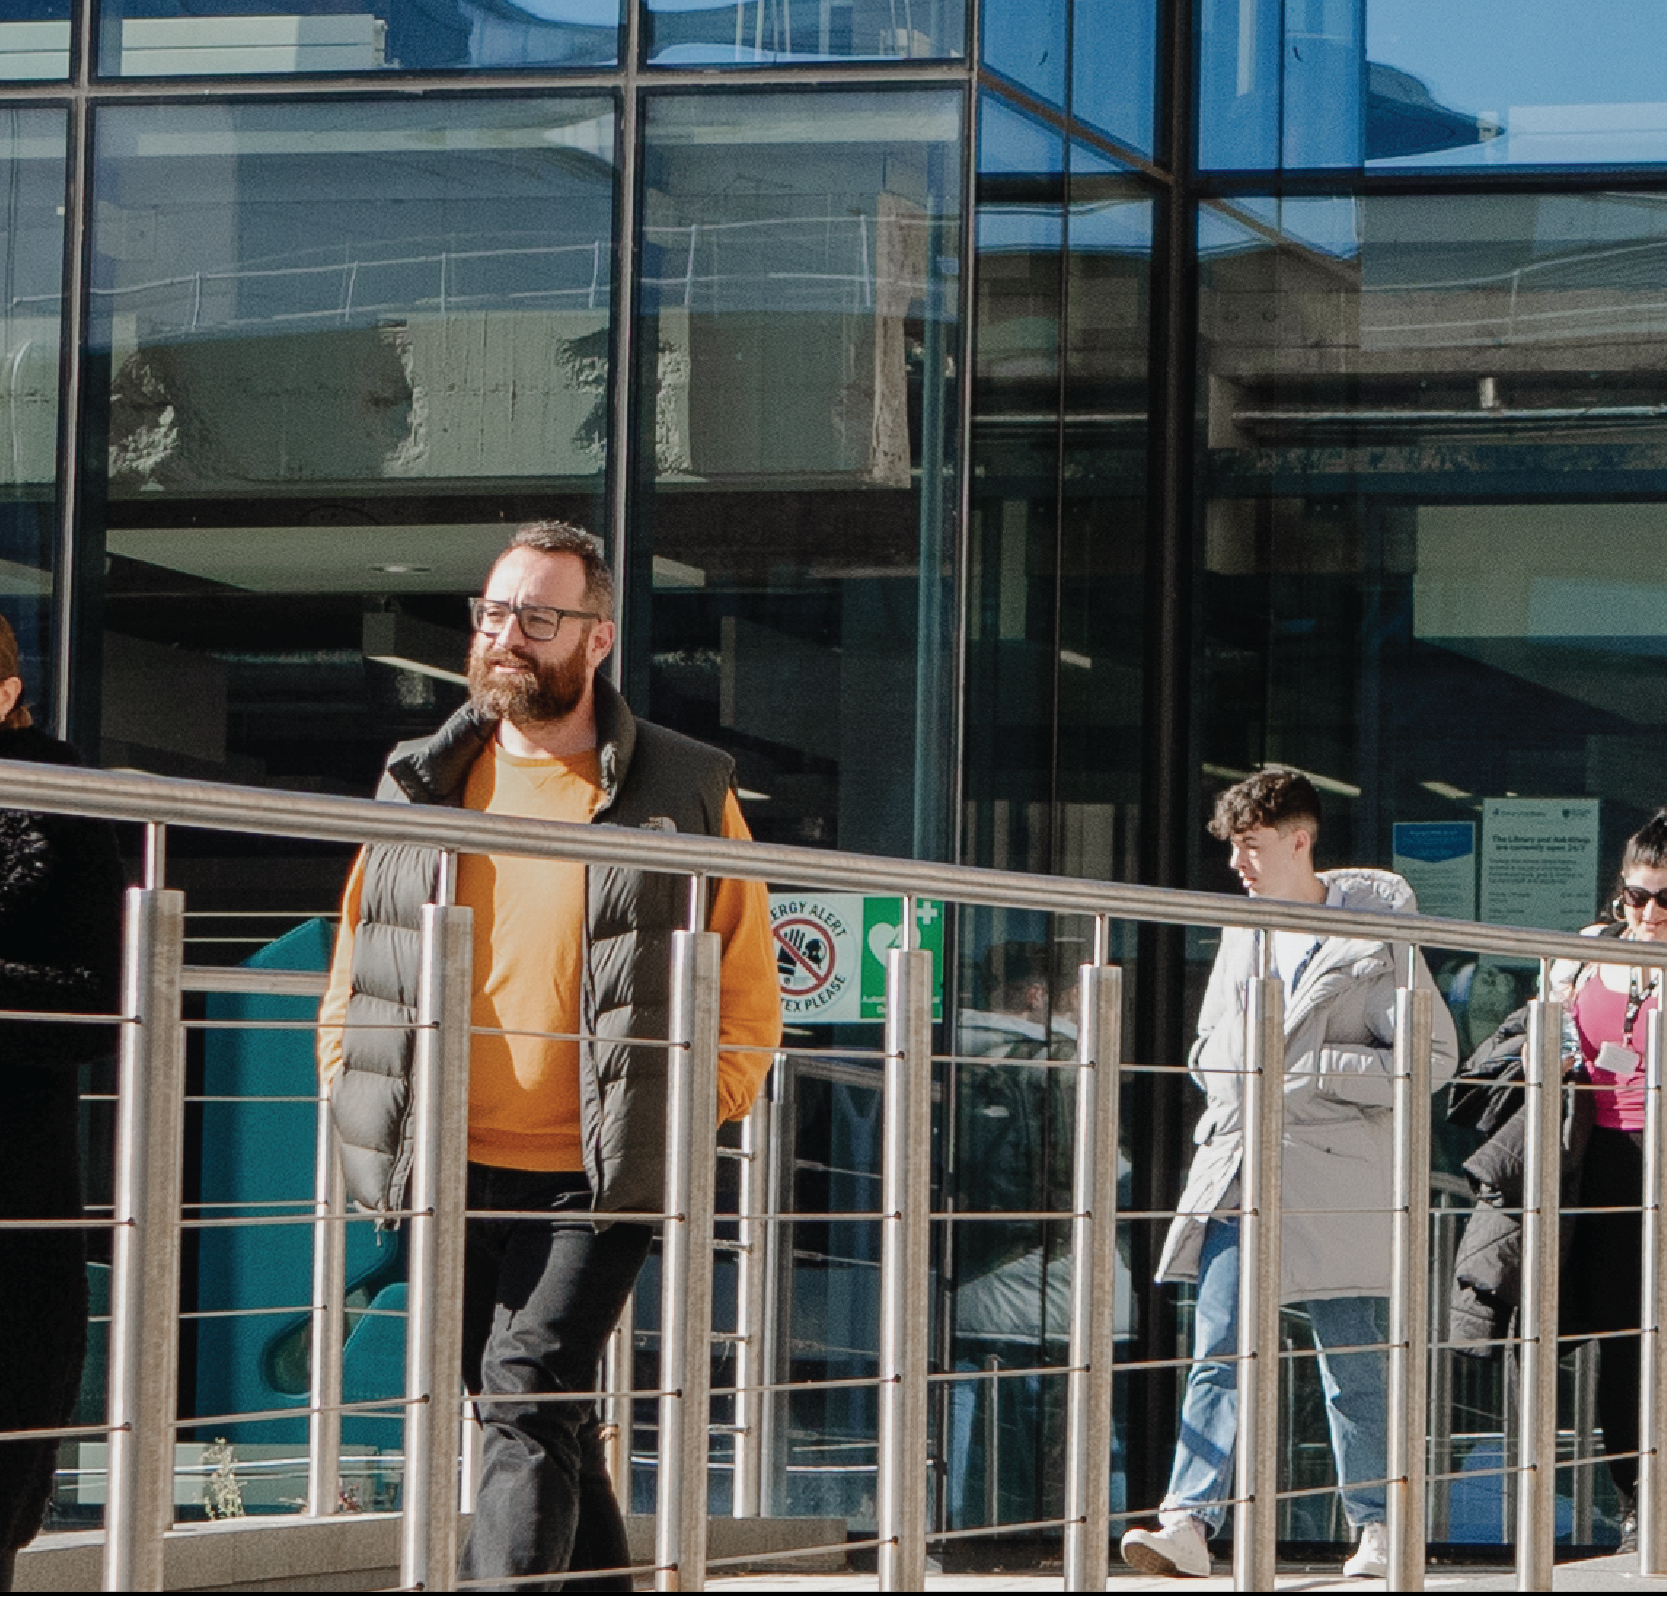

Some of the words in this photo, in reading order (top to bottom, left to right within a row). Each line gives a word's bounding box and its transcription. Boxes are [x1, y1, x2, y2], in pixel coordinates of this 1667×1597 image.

[770, 900, 808, 921] ERGY
[808, 903, 847, 937] ALERT
[804, 974, 846, 1012] PLEASE
